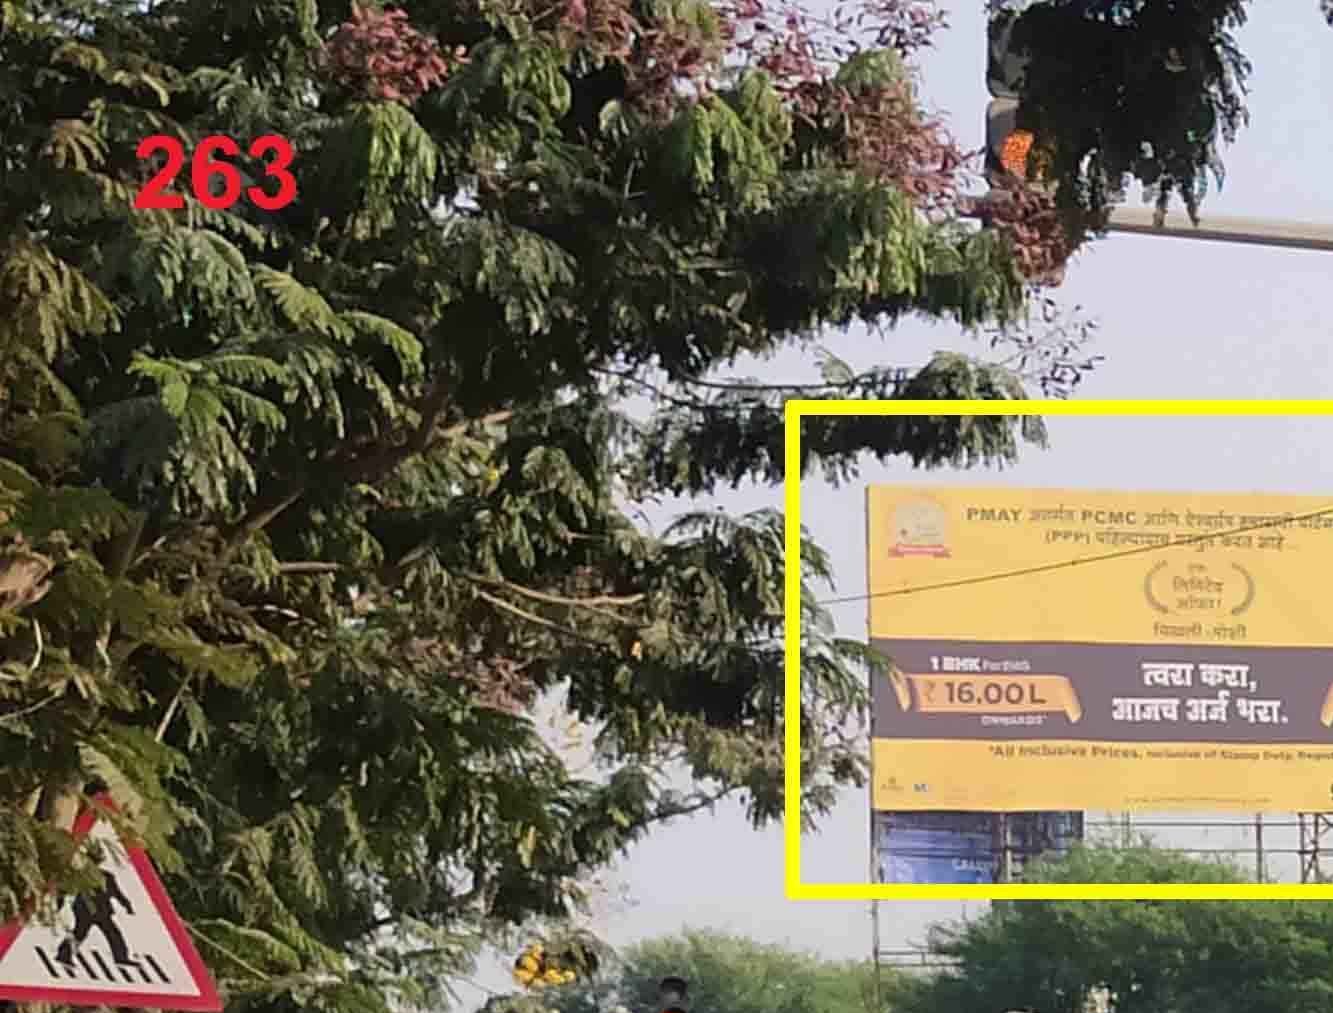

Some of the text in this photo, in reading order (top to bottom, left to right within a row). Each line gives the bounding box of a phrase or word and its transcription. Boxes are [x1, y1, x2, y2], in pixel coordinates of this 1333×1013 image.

[967, 507, 1022, 522] PMAY
[1081, 510, 1137, 525] PCMC
[1045, 530, 1090, 545] (PPP)
[930, 656, 940, 671] 1
[943, 656, 981, 672] BHK
